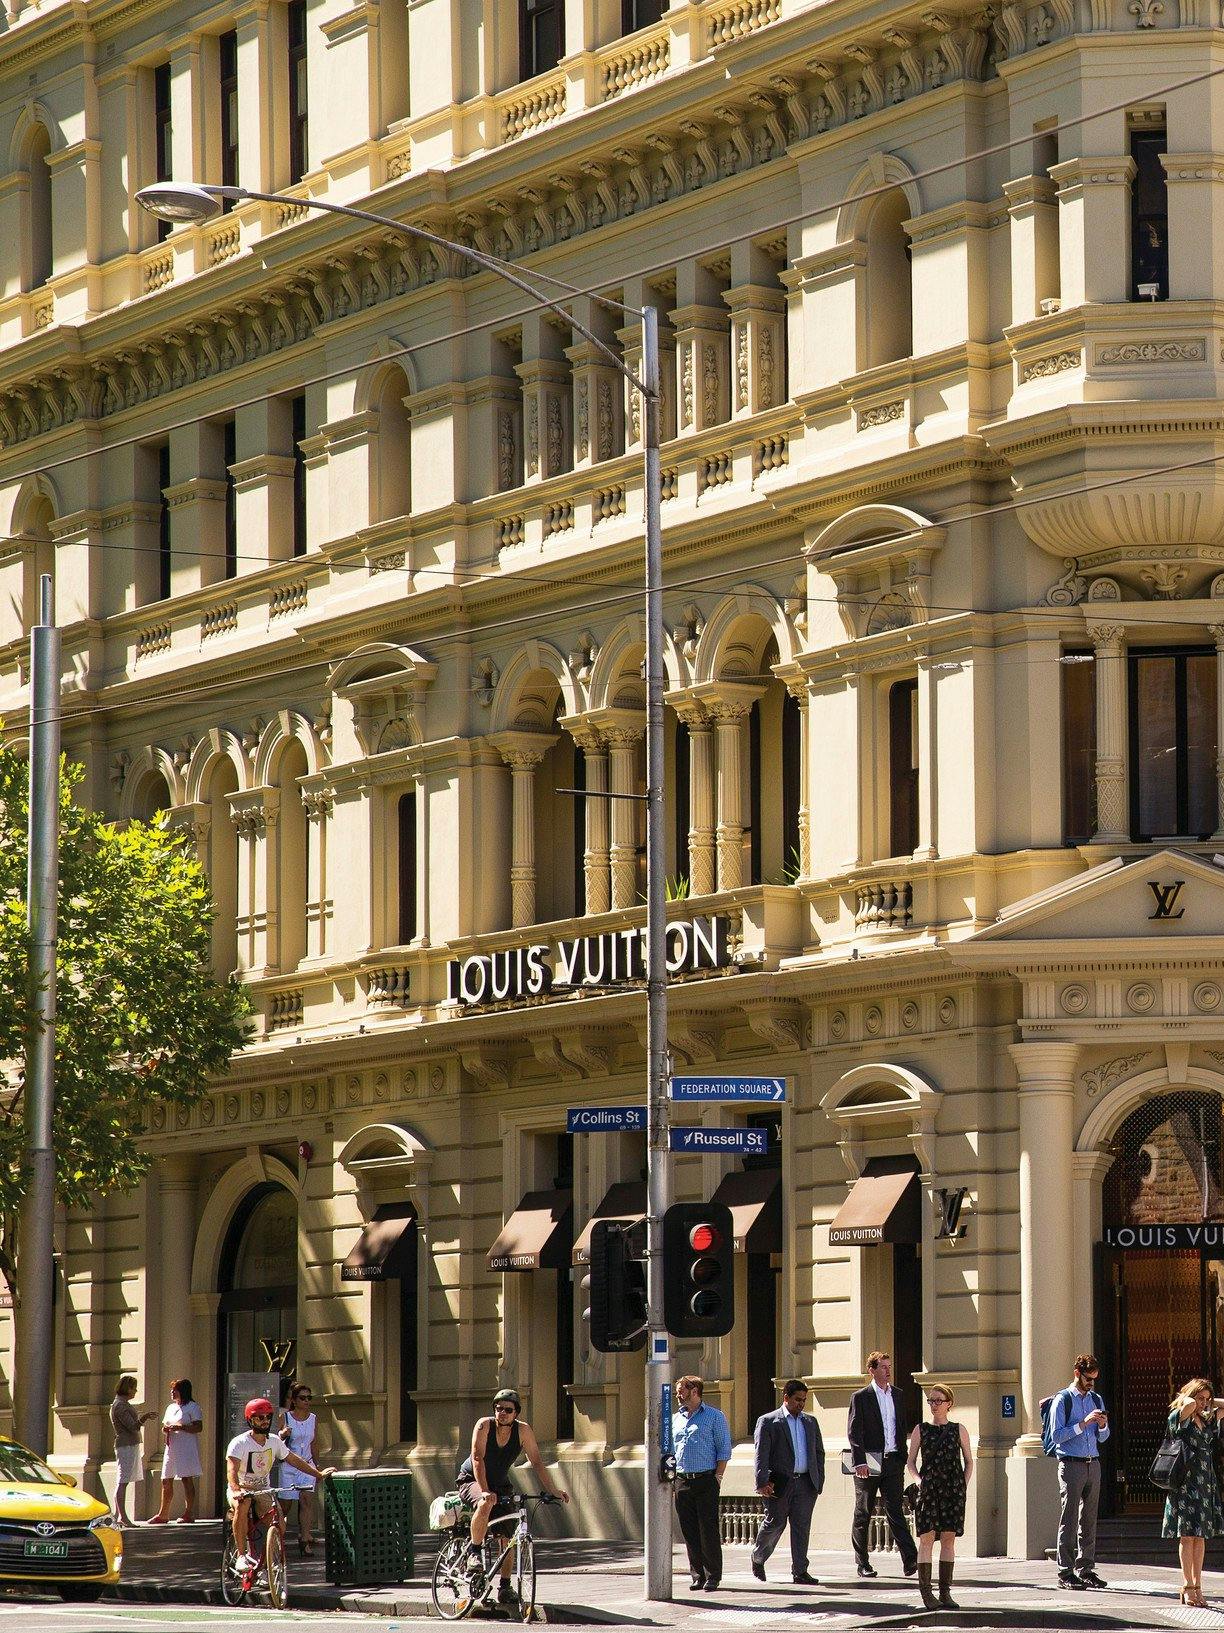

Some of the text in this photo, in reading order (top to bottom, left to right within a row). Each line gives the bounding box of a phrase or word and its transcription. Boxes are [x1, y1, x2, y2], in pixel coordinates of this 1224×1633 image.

[446, 946, 546, 1005] LOUIS
[681, 1084, 772, 1094] FEDERATION SQUARE
[581, 1110, 640, 1124] Collins St
[694, 1132, 763, 1145] Russell St
[830, 1228, 883, 1241] LOUIS VUITTON
[1106, 1228, 1177, 1247] LOUIS
[491, 1255, 535, 1268] LOUIS VUITTON
[343, 1268, 358, 1277] OUIS
[45, 1546, 64, 1555] 1041
